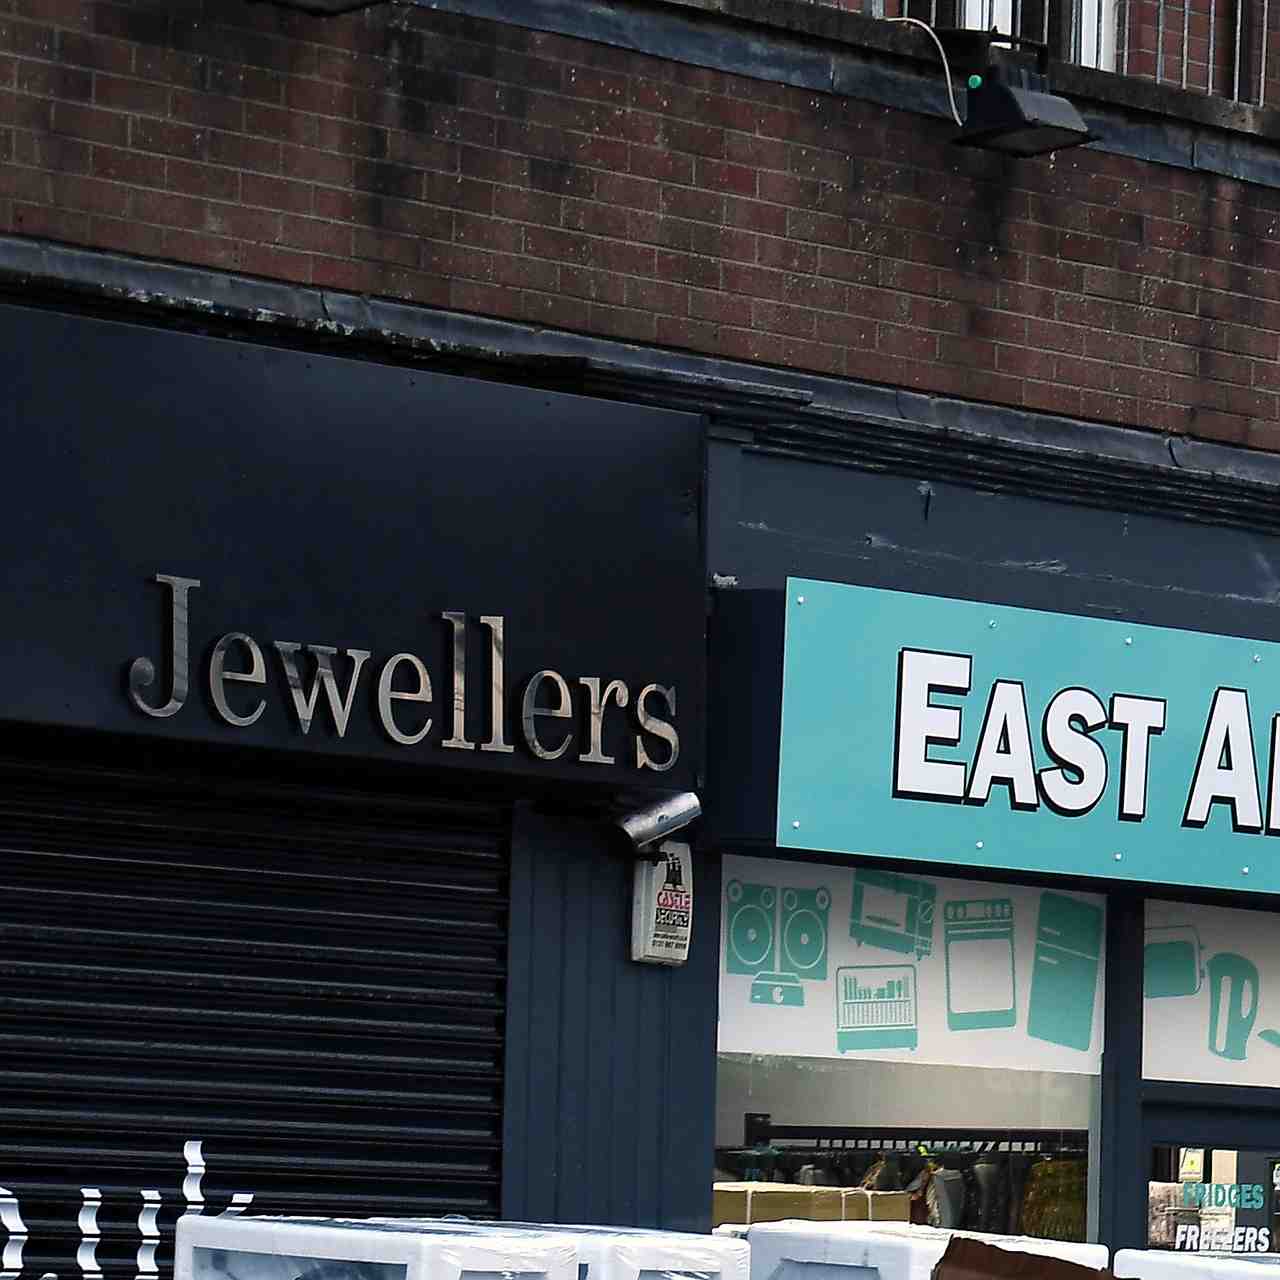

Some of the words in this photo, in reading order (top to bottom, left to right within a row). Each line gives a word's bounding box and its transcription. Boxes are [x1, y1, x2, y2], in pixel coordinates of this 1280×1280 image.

[126, 572, 681, 773] Jewellers
[893, 646, 1167, 824] EAST
[1183, 1183, 1265, 1210] FRIDGES
